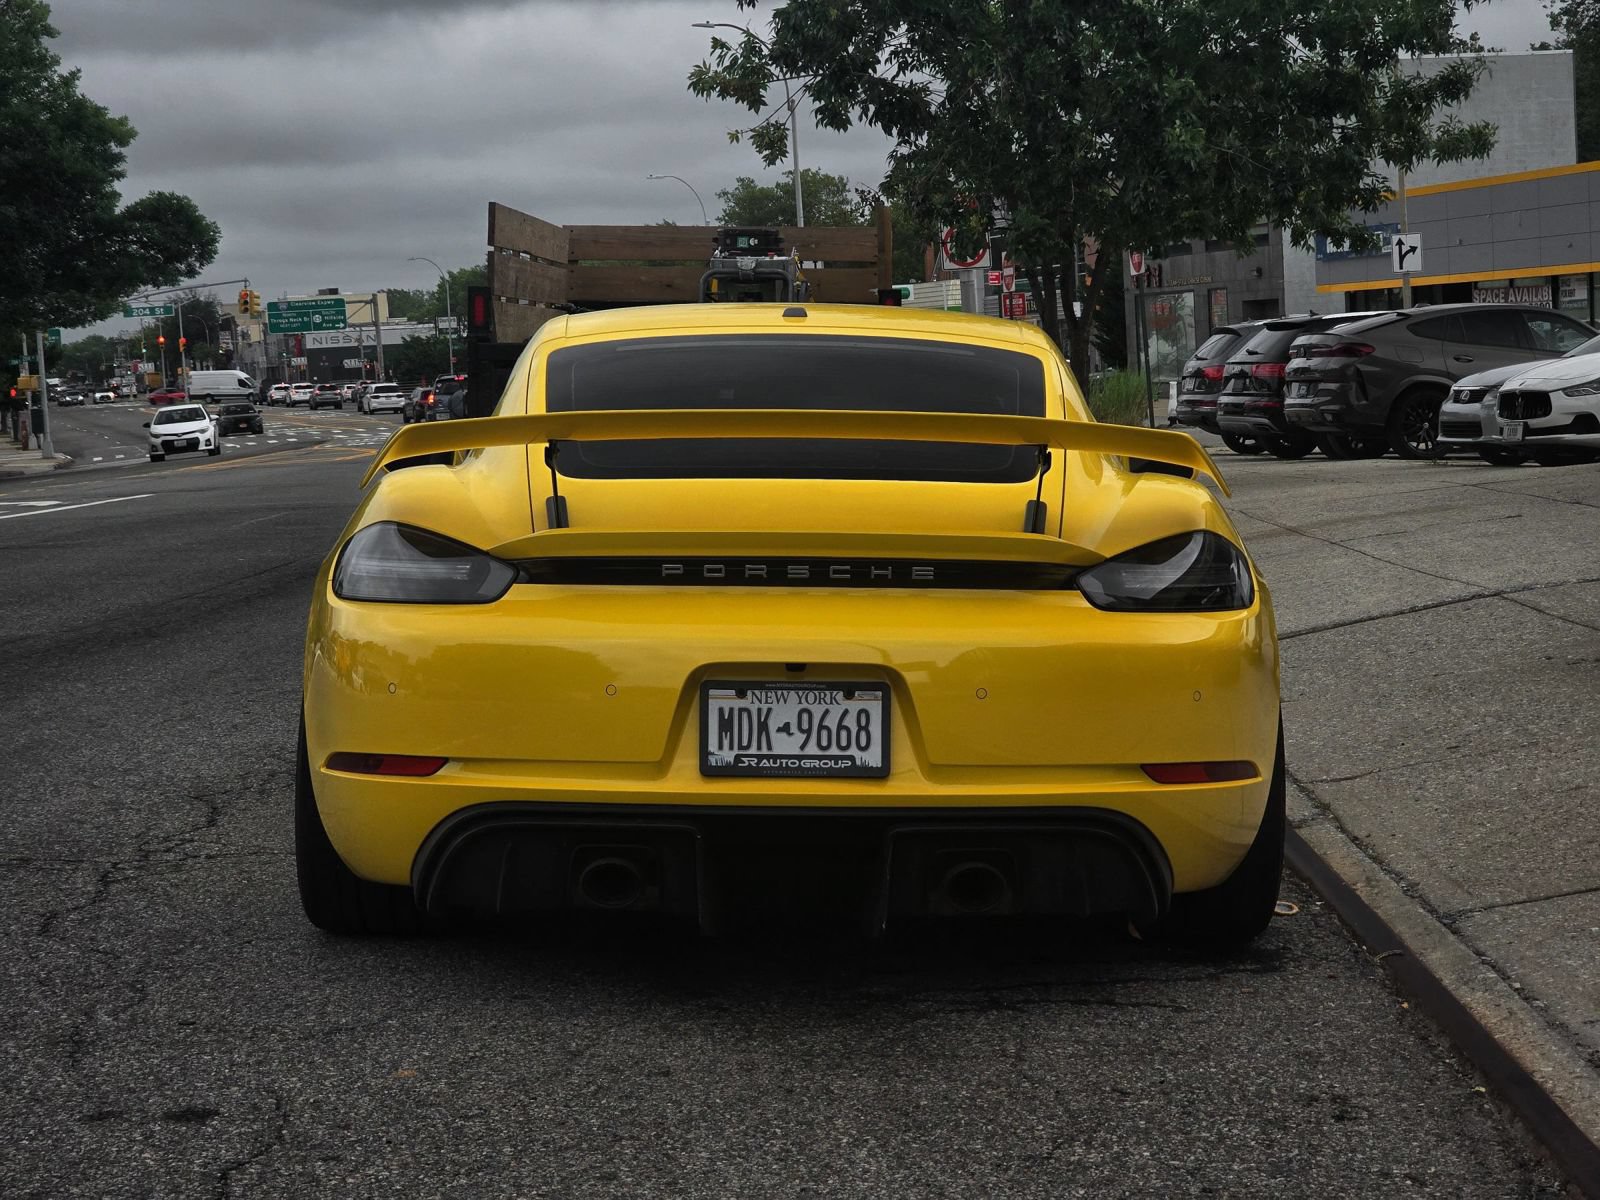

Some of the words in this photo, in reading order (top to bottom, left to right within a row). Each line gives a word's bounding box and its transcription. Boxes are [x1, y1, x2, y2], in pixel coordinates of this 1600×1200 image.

[1473, 288, 1505, 303] SPACE
[132, 308, 150, 316] 204
[154, 307, 165, 315] St
[661, 564, 935, 580] PORSCHE
[750, 691, 791, 705] NEW
[795, 690, 842, 706] YORK
[718, 706, 773, 752] MDK
[797, 707, 872, 752] 9668
[759, 757, 801, 768] AUTO
[801, 758, 852, 769] GROUP
